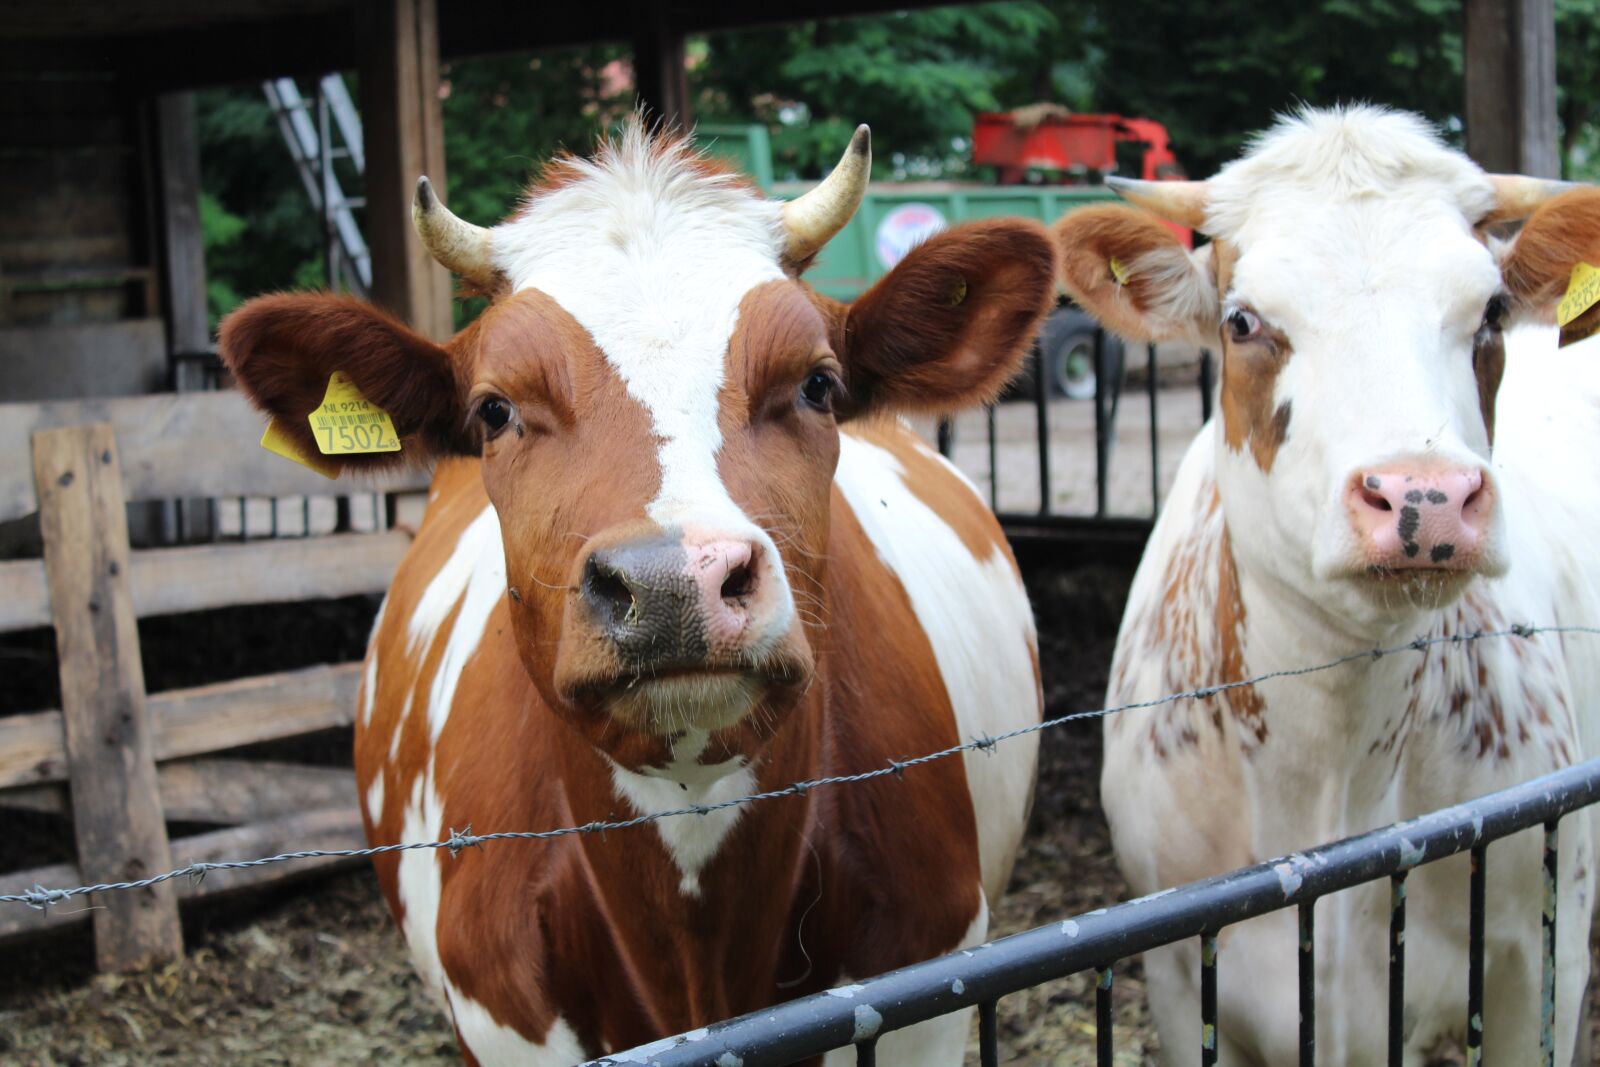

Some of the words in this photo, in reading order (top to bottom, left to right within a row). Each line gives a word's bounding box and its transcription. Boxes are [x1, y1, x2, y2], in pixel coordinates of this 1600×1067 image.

[324, 404, 338, 413] NL
[341, 401, 369, 412] 9214
[318, 424, 388, 451] 7502
